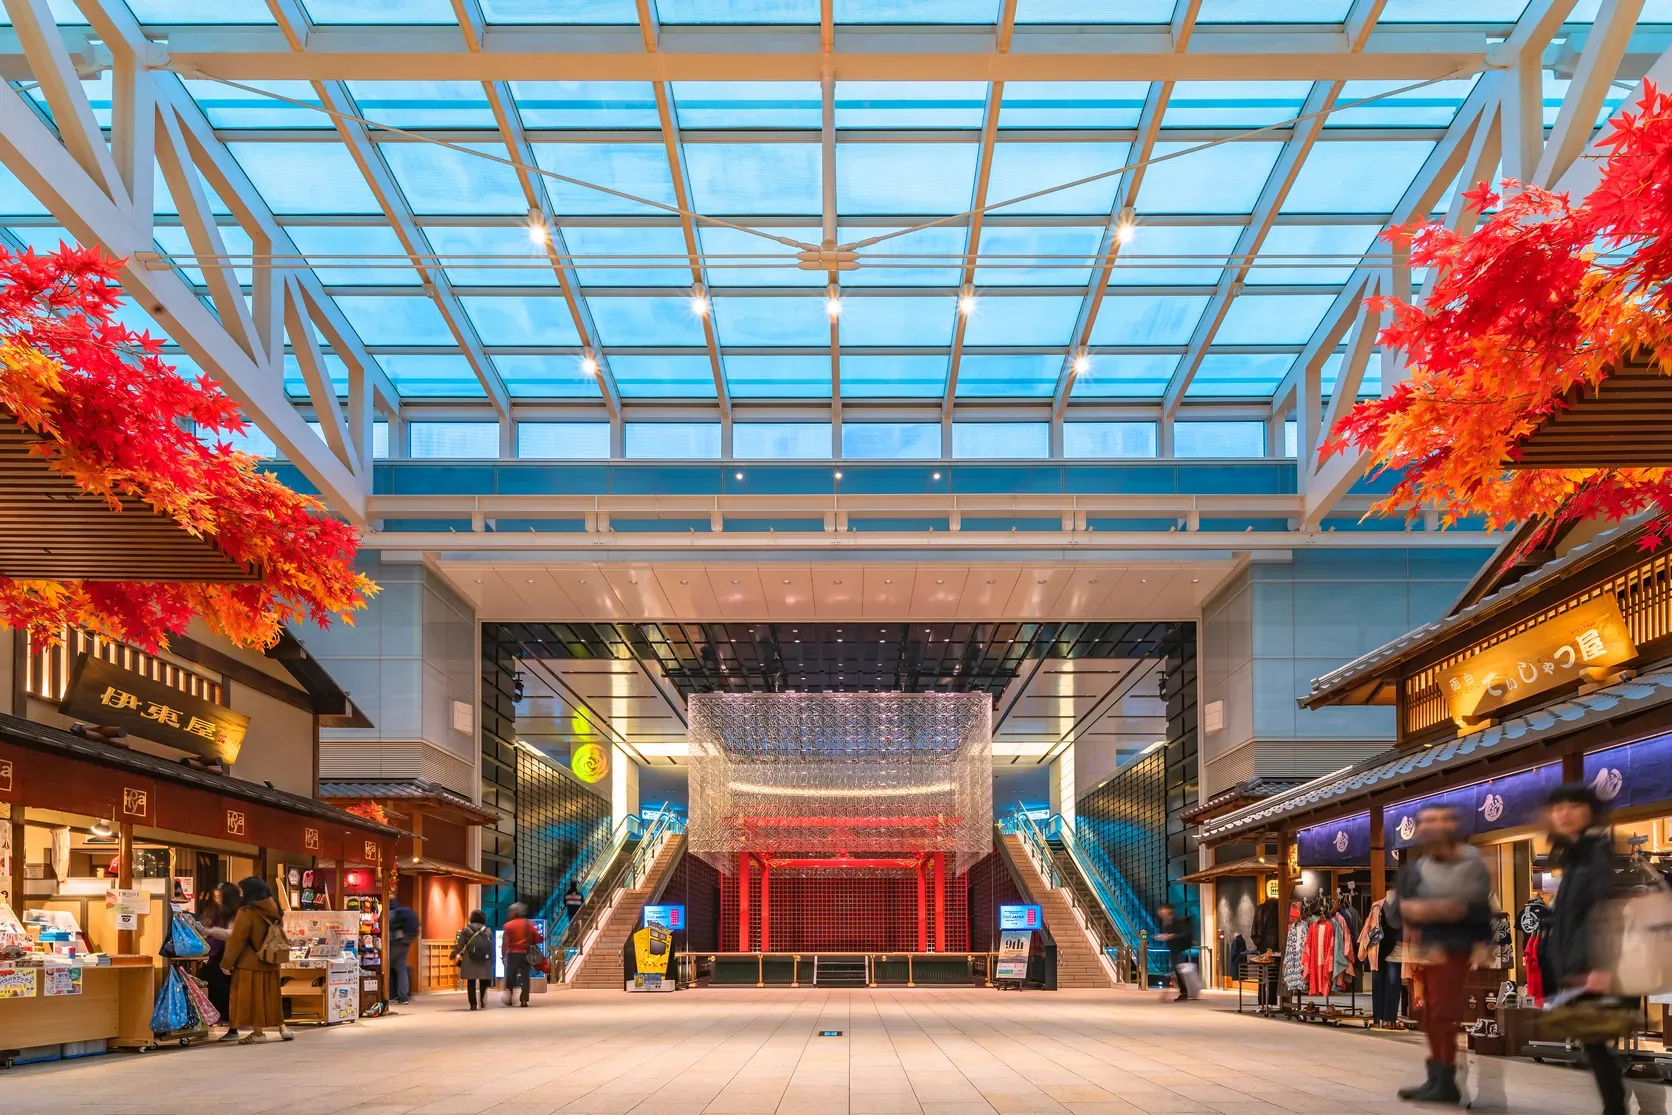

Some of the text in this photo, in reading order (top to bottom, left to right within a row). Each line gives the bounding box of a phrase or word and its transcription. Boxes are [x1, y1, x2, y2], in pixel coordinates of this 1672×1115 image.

[100, 686, 217, 741] 伊東屋
[1005, 939, 1024, 950] 9th
